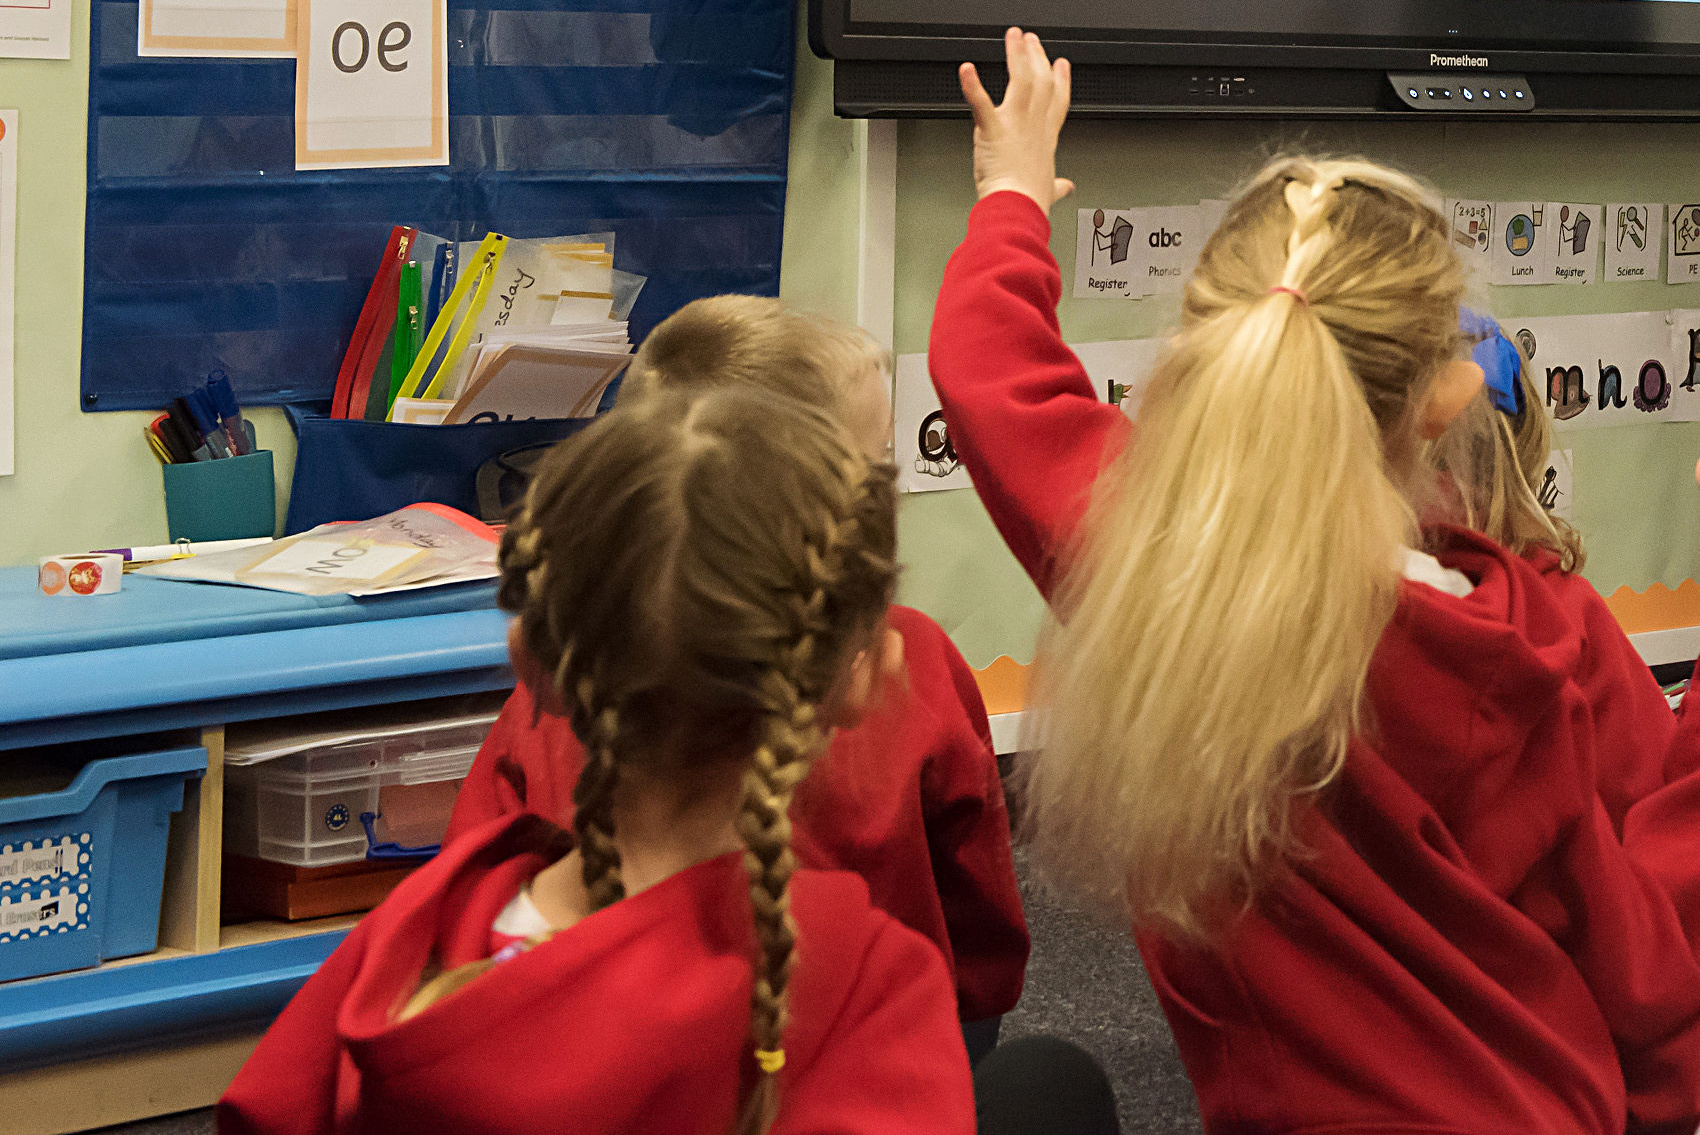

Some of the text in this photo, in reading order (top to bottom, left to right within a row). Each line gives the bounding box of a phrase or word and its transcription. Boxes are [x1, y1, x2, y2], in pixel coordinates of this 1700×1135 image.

[332, 20, 412, 74] oe
[1430, 54, 1488, 67] Promethean
[1149, 227, 1182, 248] abc
[1511, 265, 1534, 276] Lunch
[1555, 266, 1585, 279] Register
[1617, 266, 1644, 276] Science
[1688, 264, 1698, 274] PE
[1088, 277, 1128, 291] Register
